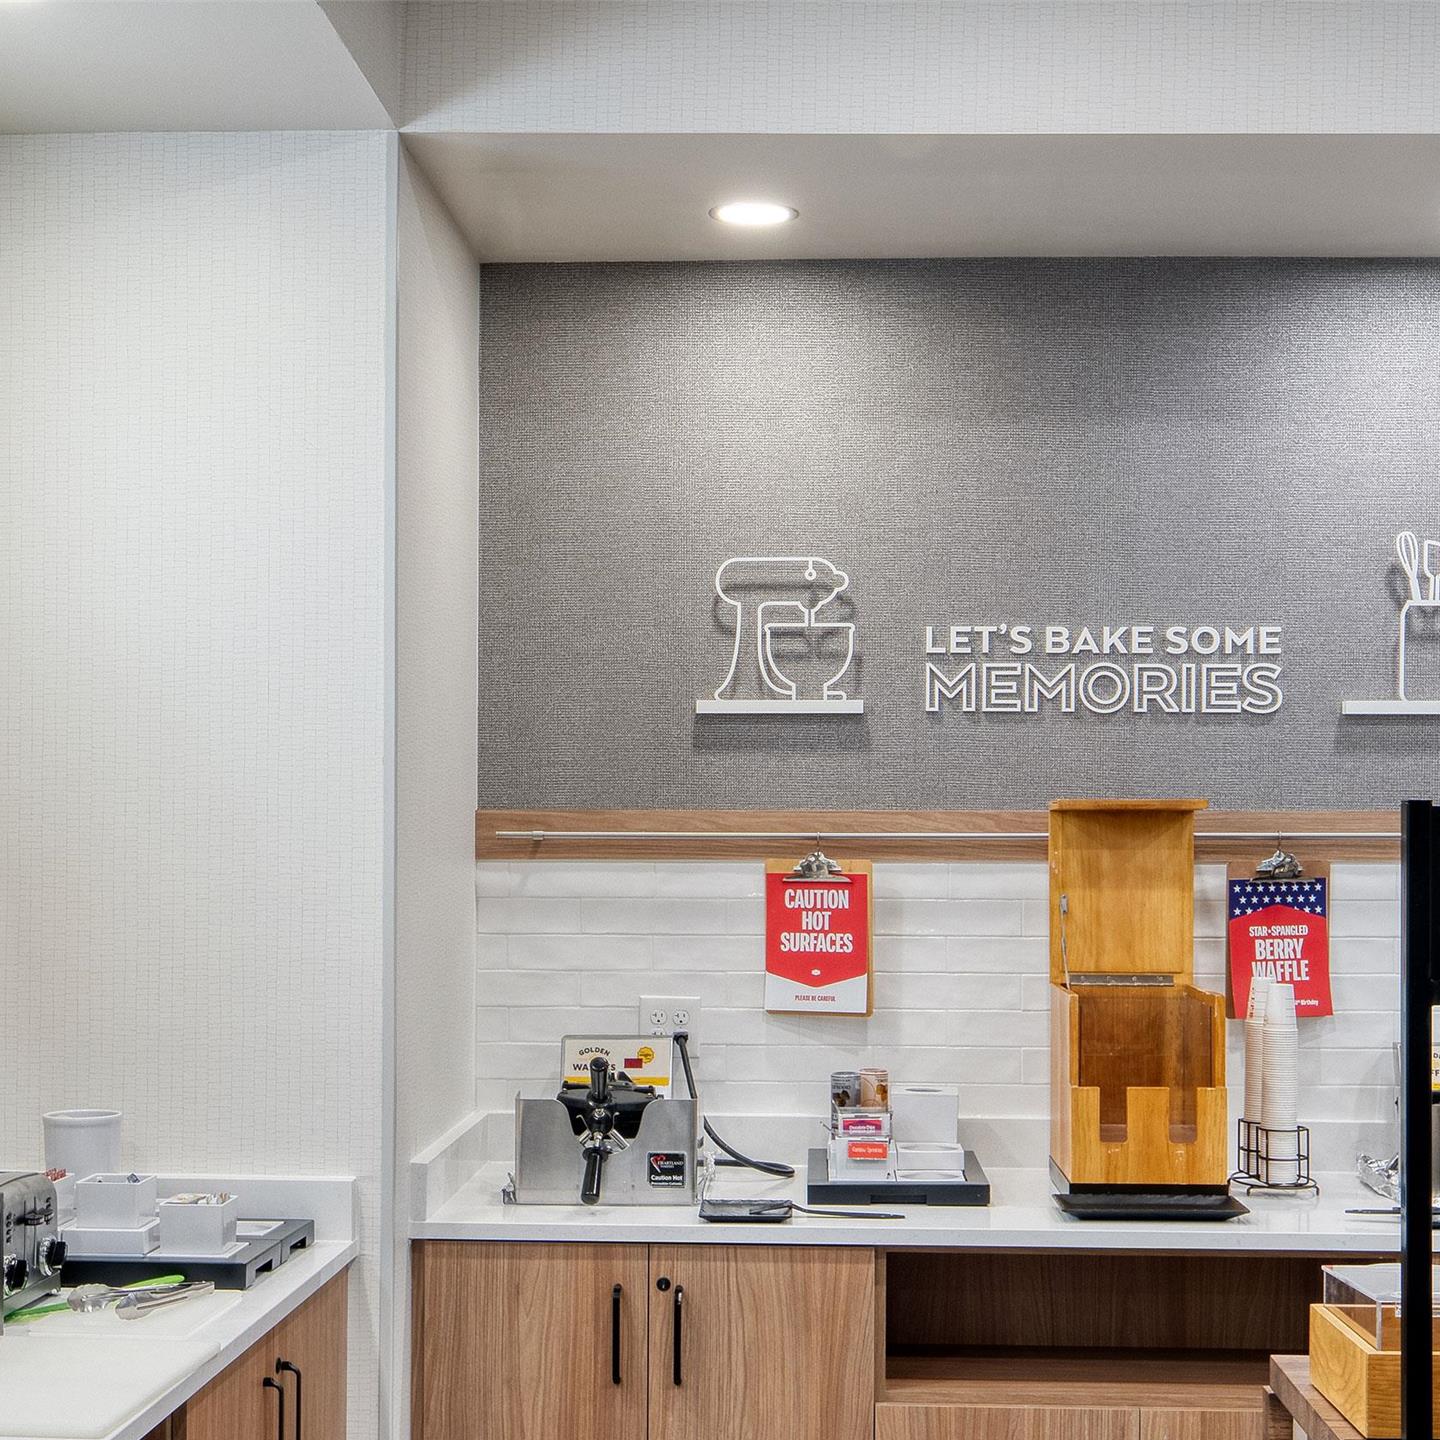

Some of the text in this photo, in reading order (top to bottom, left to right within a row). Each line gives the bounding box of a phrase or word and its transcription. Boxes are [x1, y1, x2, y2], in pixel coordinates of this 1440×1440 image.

[925, 623, 1282, 655] LET'S BAKE SOME
[925, 662, 1284, 714] MEMORIES
[784, 889, 849, 909] CAUTION
[802, 911, 831, 931] HOT
[780, 933, 854, 953] SURFACES
[1254, 938, 1304, 960] BERRY
[1251, 960, 1310, 982] WAFFLE
[578, 1046, 611, 1057] GOLDEN
